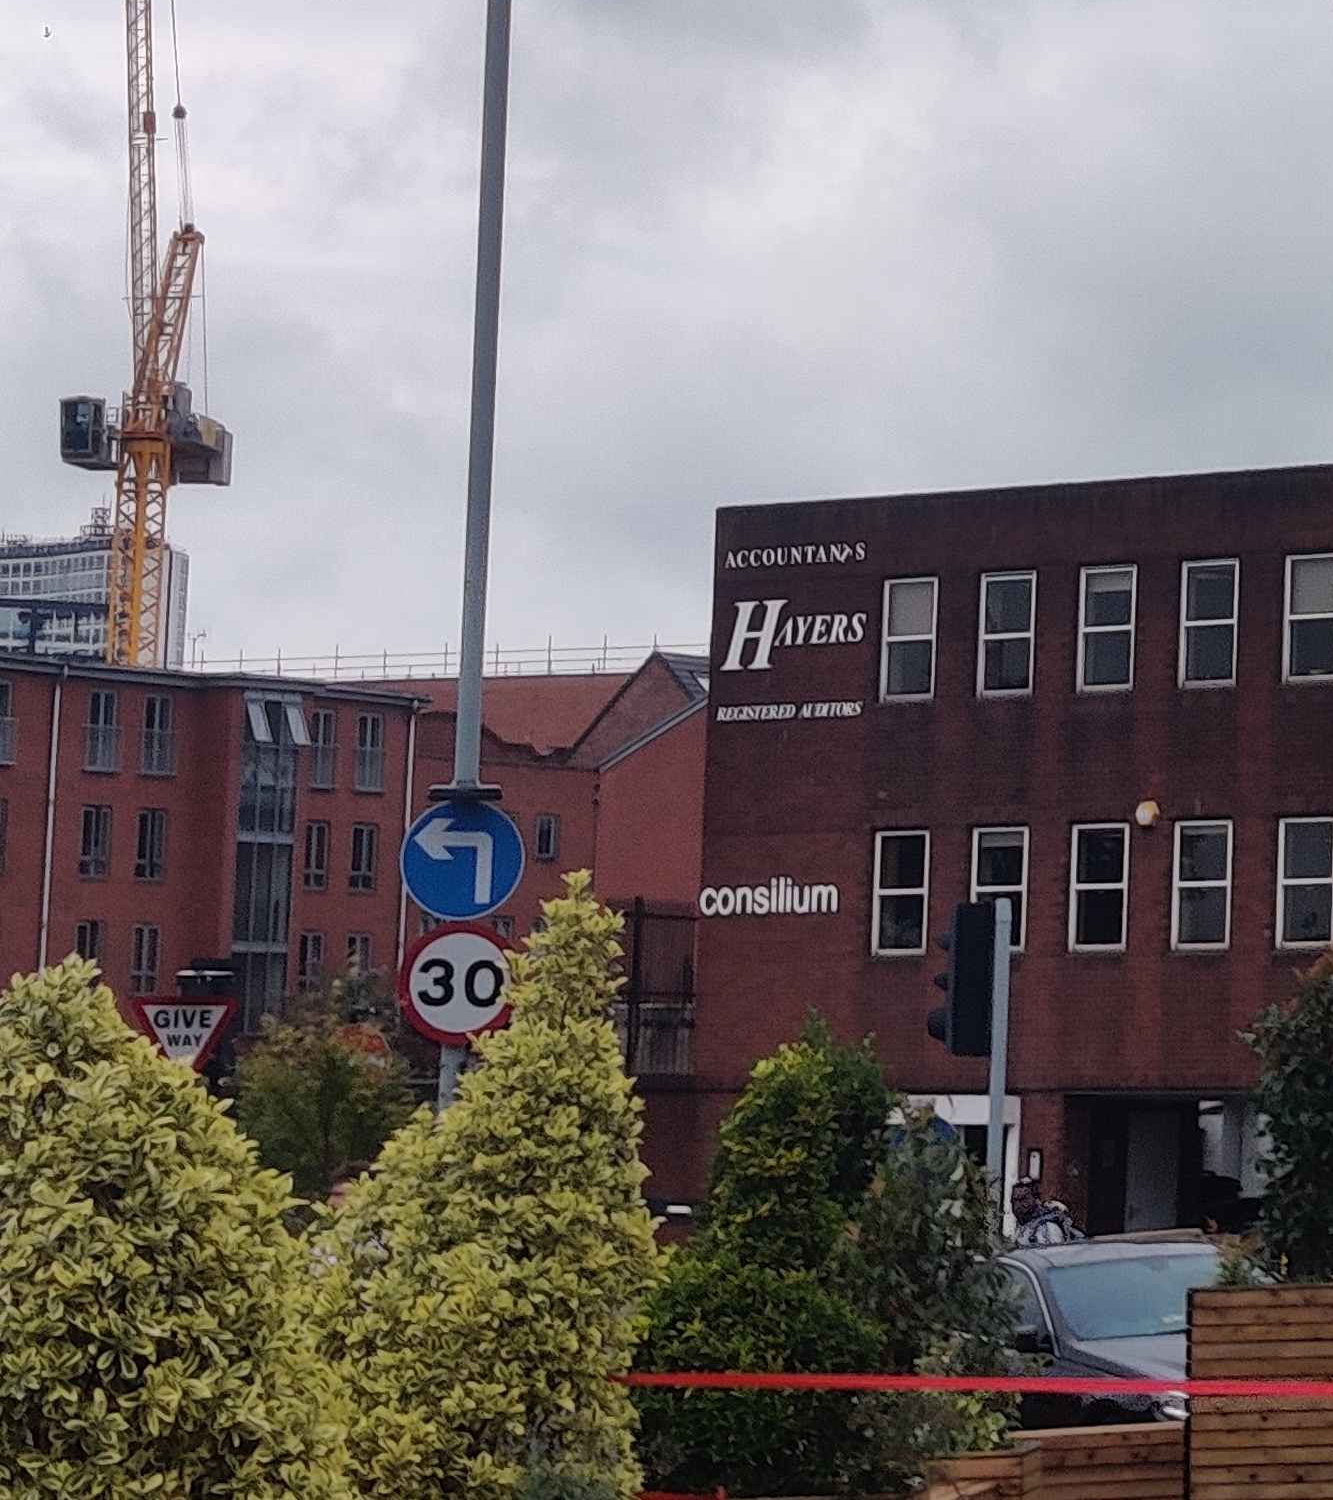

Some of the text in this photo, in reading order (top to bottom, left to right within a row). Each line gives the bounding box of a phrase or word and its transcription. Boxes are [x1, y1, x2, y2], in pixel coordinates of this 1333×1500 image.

[719, 599, 868, 671] HAYERS
[716, 701, 864, 722] REGISTERED AUDITORS
[699, 876, 839, 916] consilium
[417, 957, 505, 1008] 30
[152, 1009, 213, 1029] GIVE
[166, 1032, 204, 1048] WAY
